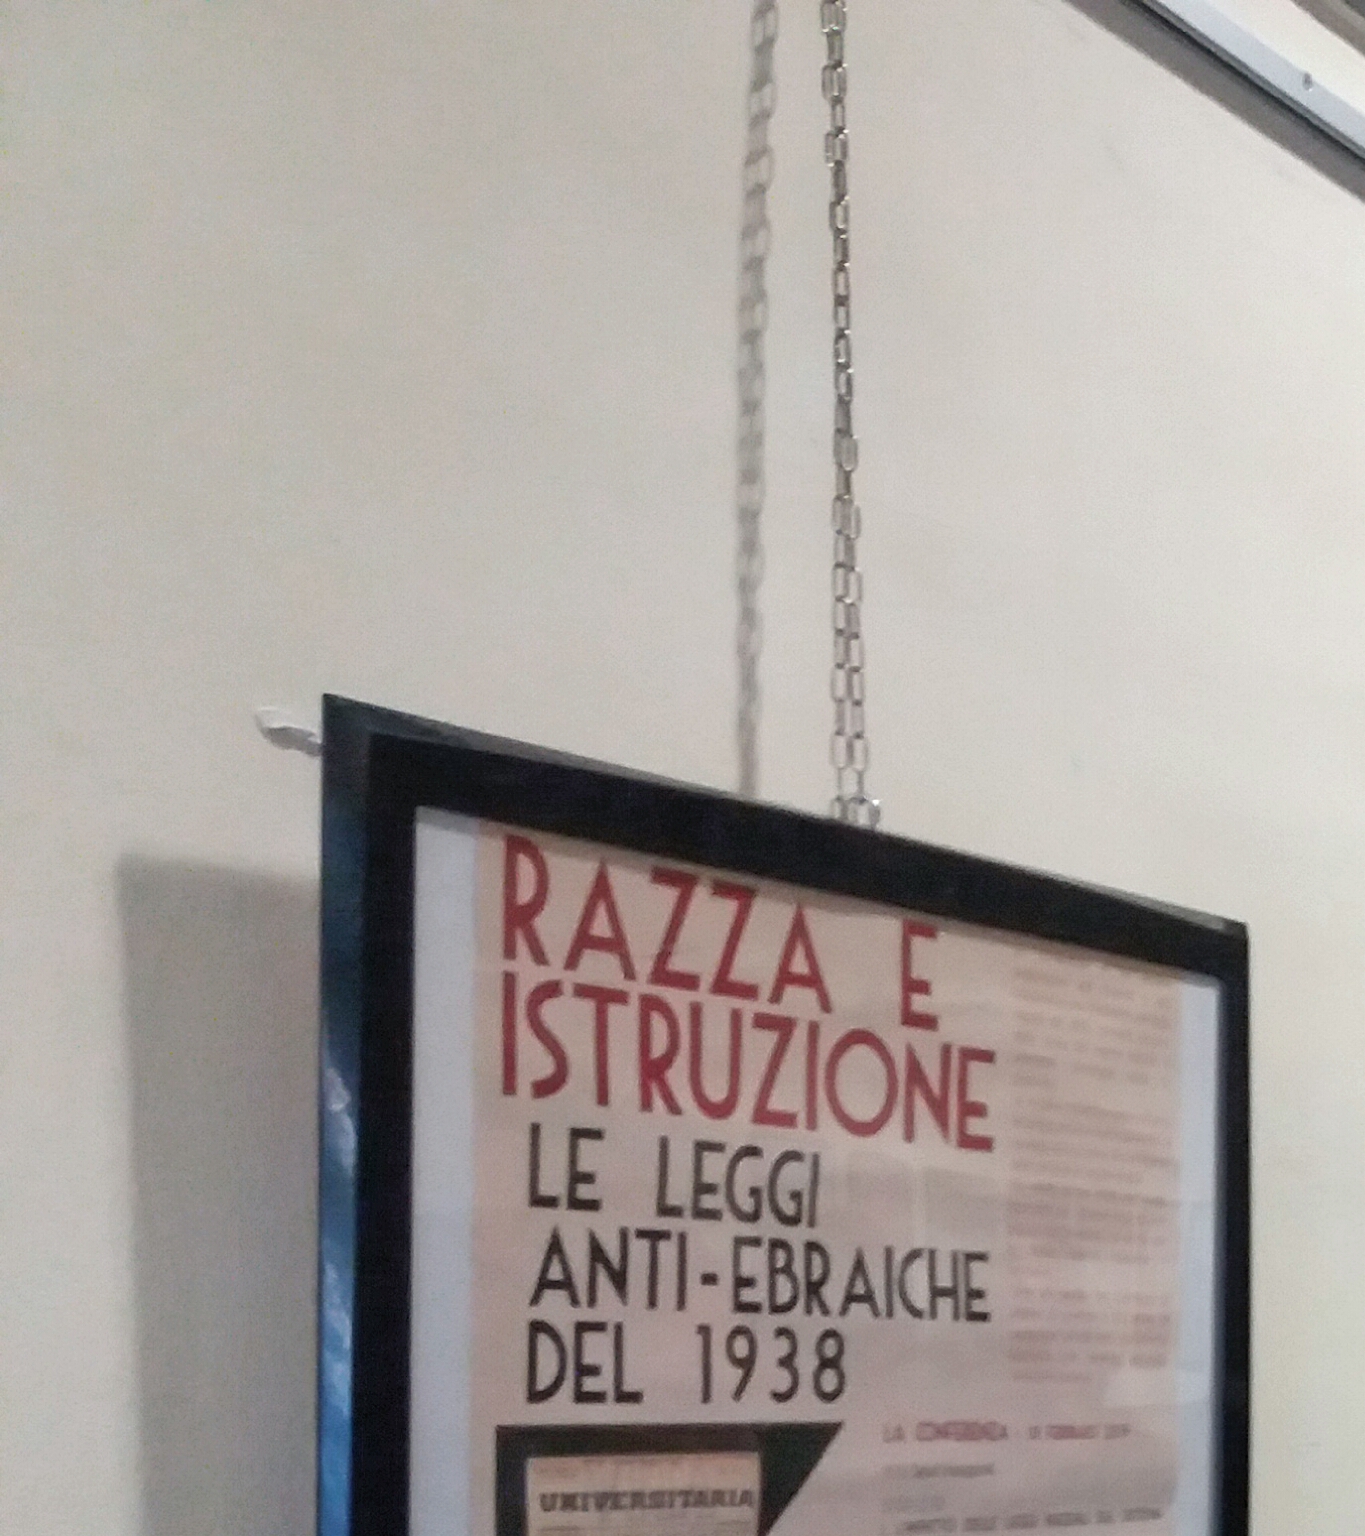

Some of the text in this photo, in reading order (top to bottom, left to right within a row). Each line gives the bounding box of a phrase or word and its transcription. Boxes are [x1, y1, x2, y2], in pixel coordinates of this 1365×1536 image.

[501, 834, 939, 1031] RAZZA E
[501, 971, 995, 1151] ISTRUZIONE
[528, 1122, 821, 1229] LE LEGGI
[528, 1226, 991, 1324] ANTI-EBRAICHE
[526, 1320, 846, 1404] DEL 1938
[539, 1488, 753, 1512] UNIVERSITARIA
